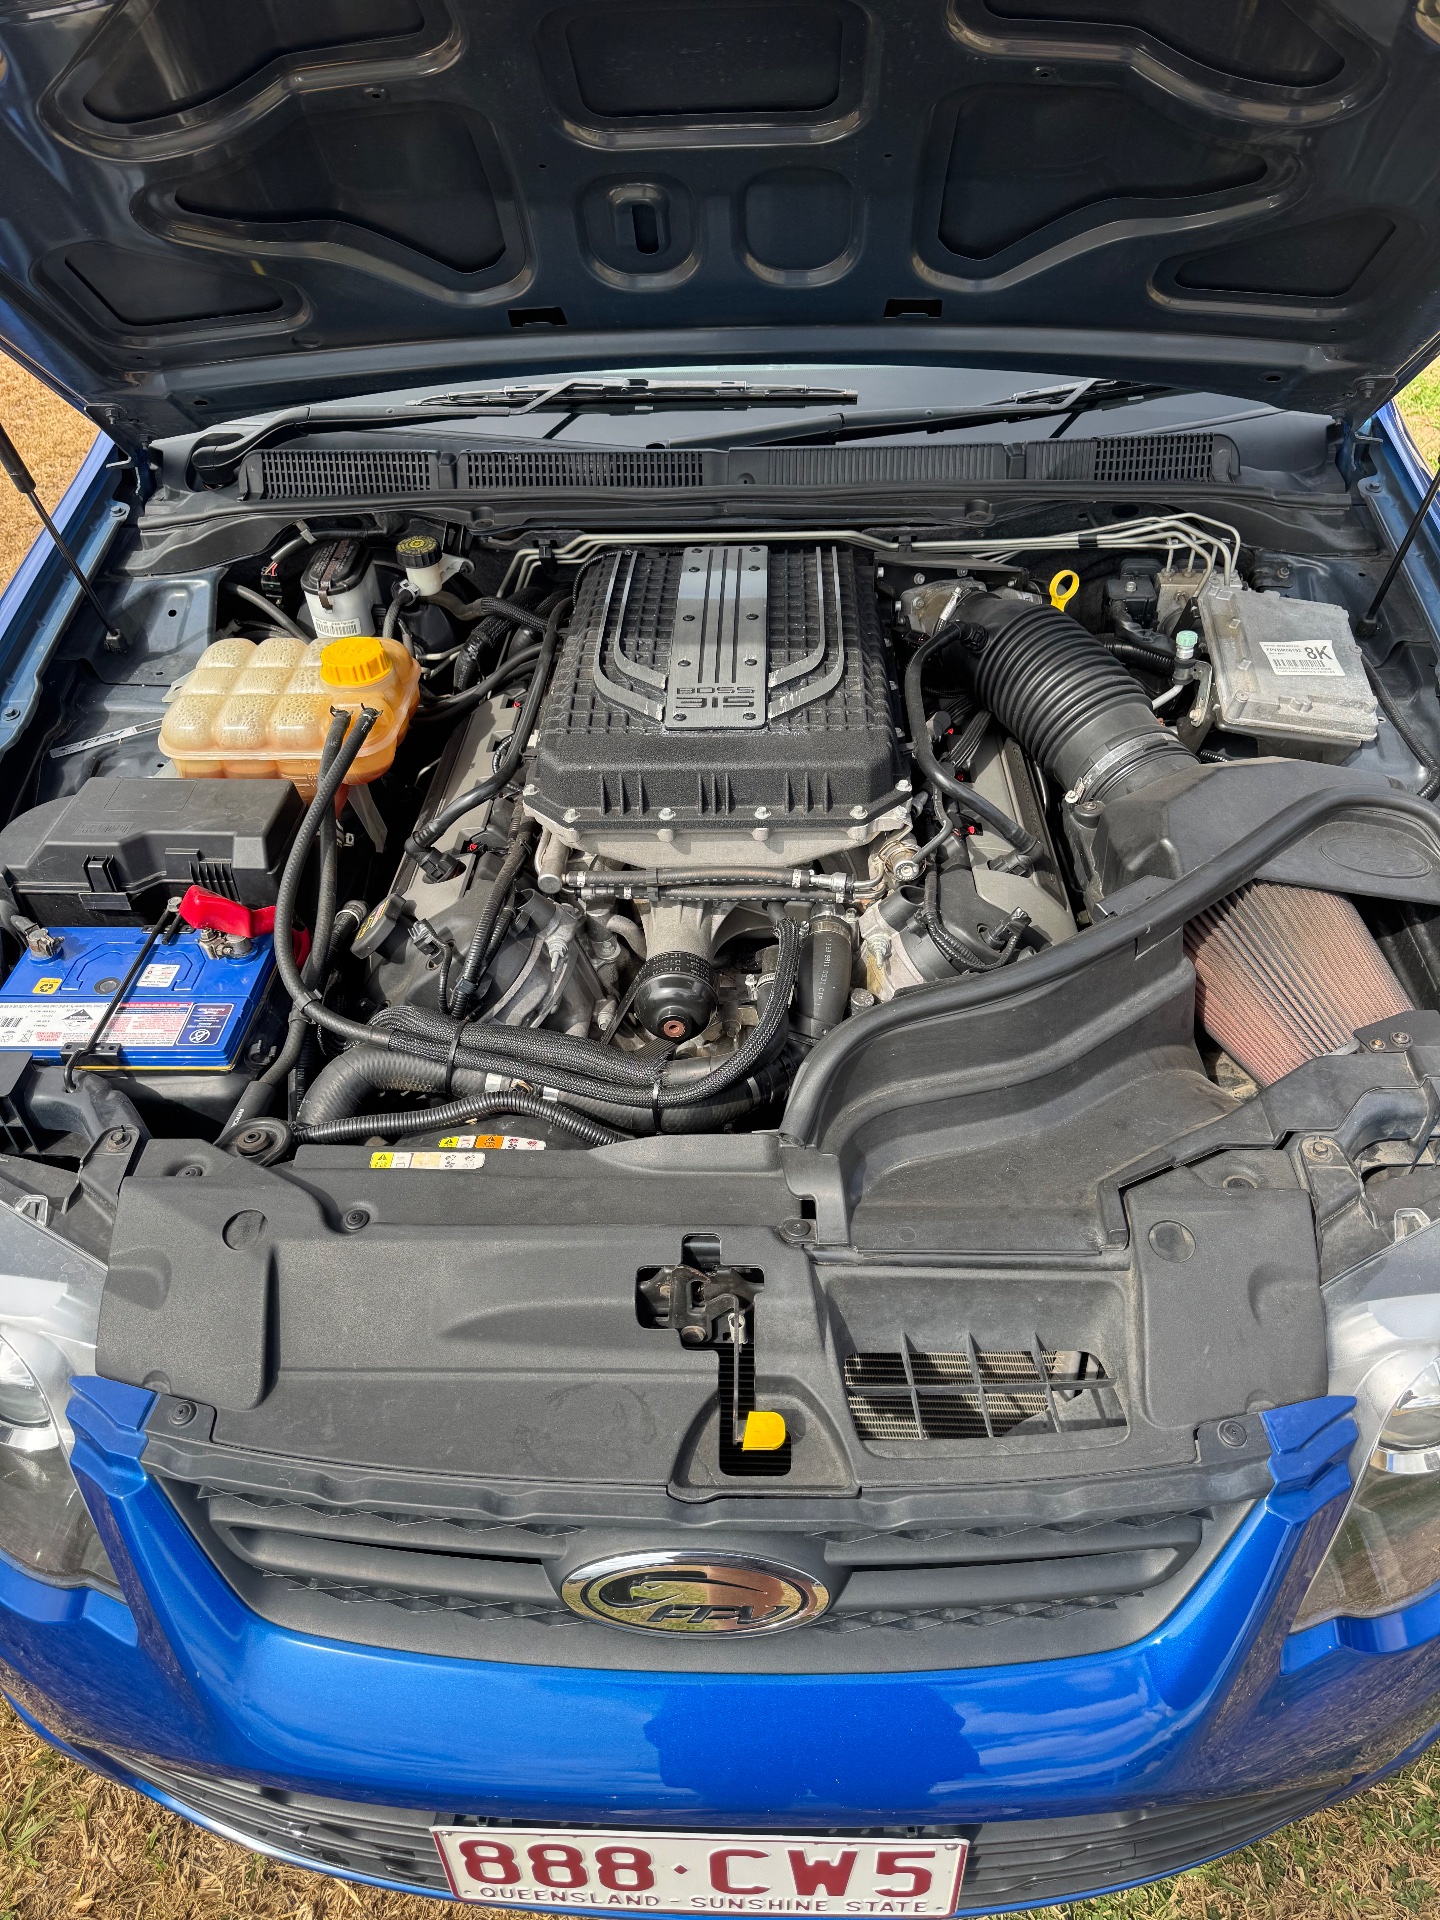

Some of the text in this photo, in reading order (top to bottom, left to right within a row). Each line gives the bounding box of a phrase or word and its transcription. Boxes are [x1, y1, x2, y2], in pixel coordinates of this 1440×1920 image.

[1304, 646, 1334, 660] 8K
[676, 686, 755, 695] BOSS
[675, 696, 755, 709] 315
[646, 1604, 790, 1625] FPV
[458, 1839, 937, 1898] 888 CW5
[479, 1886, 660, 1907] QUEENSLAND
[690, 1896, 829, 1911] SUNSHINE
[845, 1900, 928, 1913] STATE
